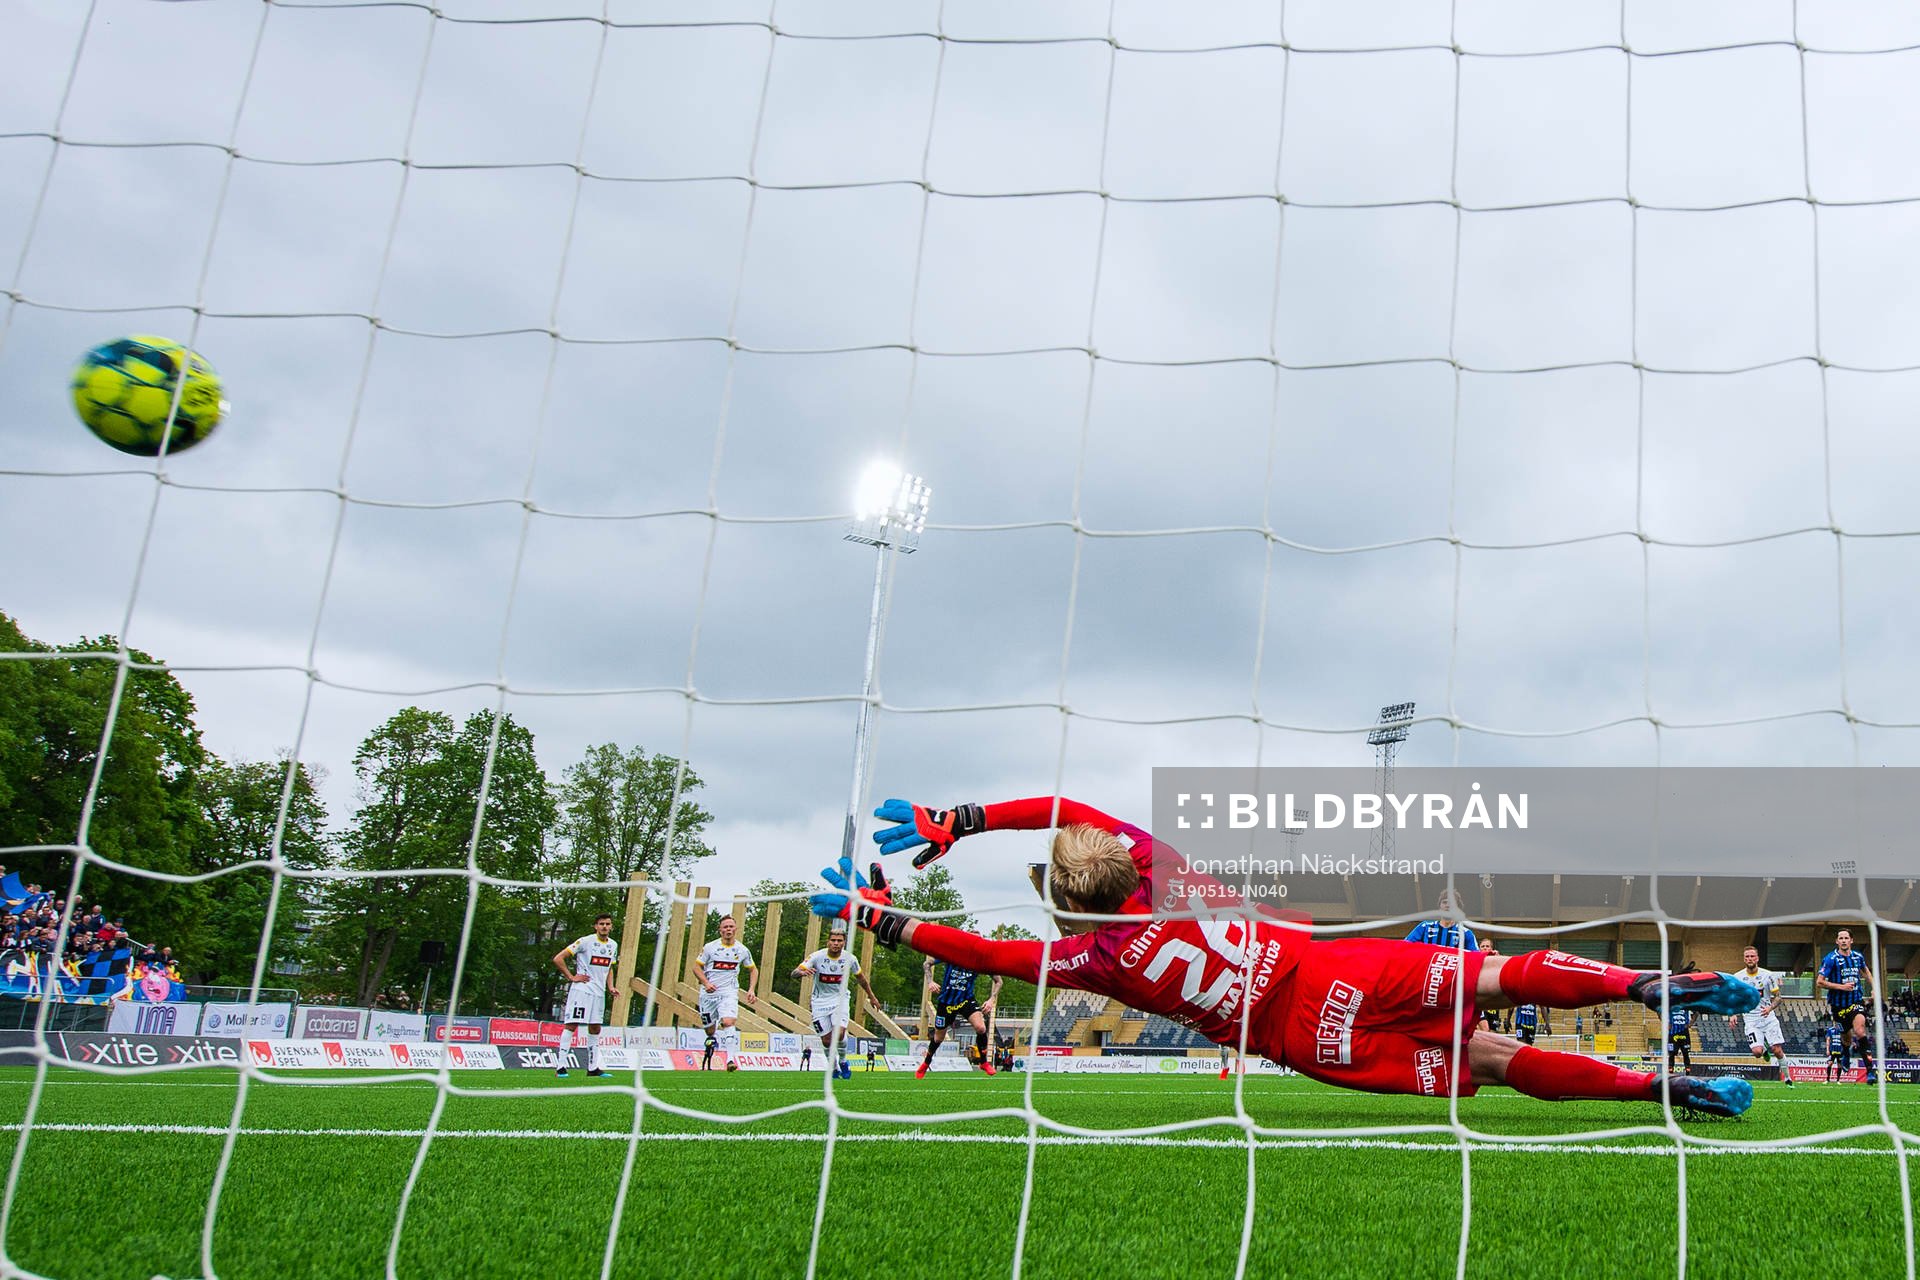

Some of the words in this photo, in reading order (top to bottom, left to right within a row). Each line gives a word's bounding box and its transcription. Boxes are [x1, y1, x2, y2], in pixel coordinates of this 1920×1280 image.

[1143, 892, 1247, 1011] 26
[1424, 953, 1449, 1007] kungälvs
[308, 1014, 357, 1033] colorama
[89, 1037, 159, 1065] xite
[174, 1039, 239, 1064] xite
[274, 1046, 321, 1056] SVENSKA
[345, 1047, 385, 1057] SVENSKA
[279, 1057, 304, 1067] SPEL
[348, 1058, 371, 1067] SPEL
[757, 1056, 792, 1068] MOTOR
[1180, 1059, 1211, 1070] mella
